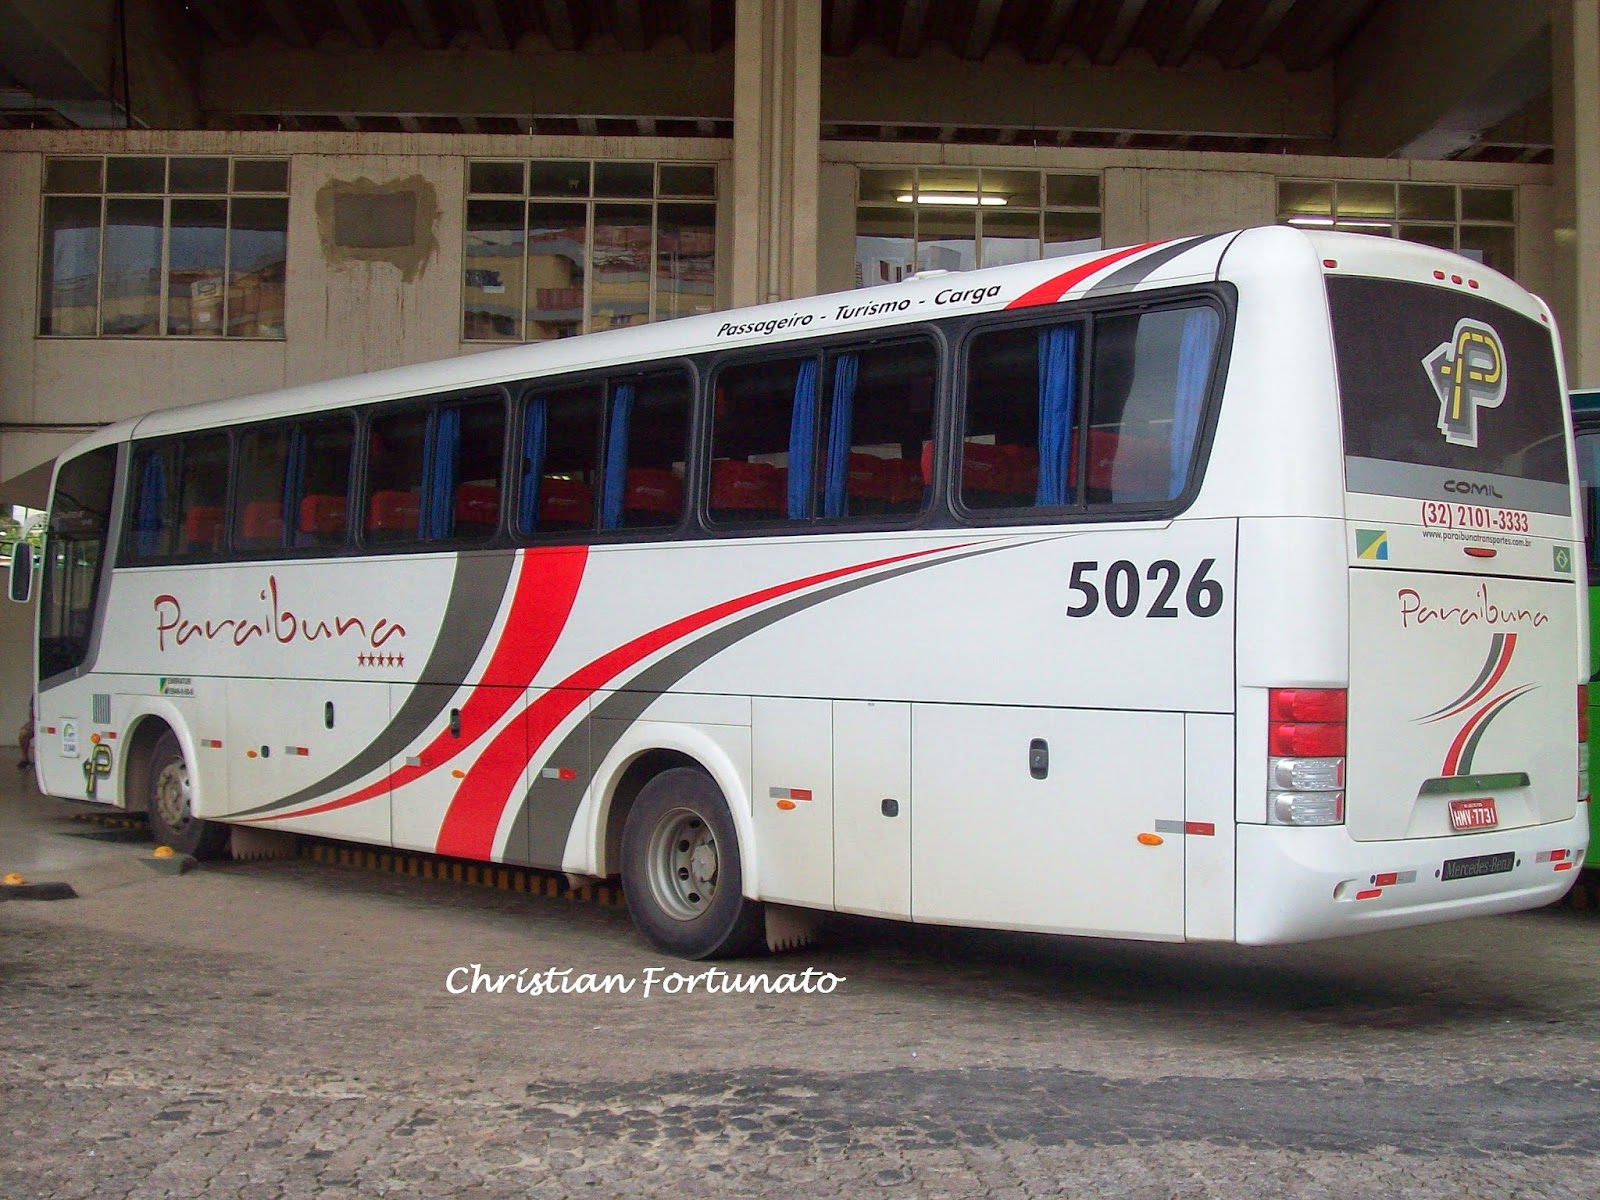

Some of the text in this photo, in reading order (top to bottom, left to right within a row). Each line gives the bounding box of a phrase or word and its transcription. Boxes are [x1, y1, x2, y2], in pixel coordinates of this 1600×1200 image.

[716, 311, 813, 337] Passageiro
[834, 297, 911, 322] Turismo
[934, 283, 1002, 306] Carga
[1443, 479, 1503, 499] COMIL
[1421, 500, 1530, 533] (32) 2101-3333
[1422, 530, 1532, 548] www.paraibunatransportes.com.br
[1066, 558, 1225, 618] 5026
[1398, 582, 1549, 628] Paraibuna
[153, 574, 406, 652] Paraibuna
[1446, 856, 1512, 878] Mercedes-Benz
